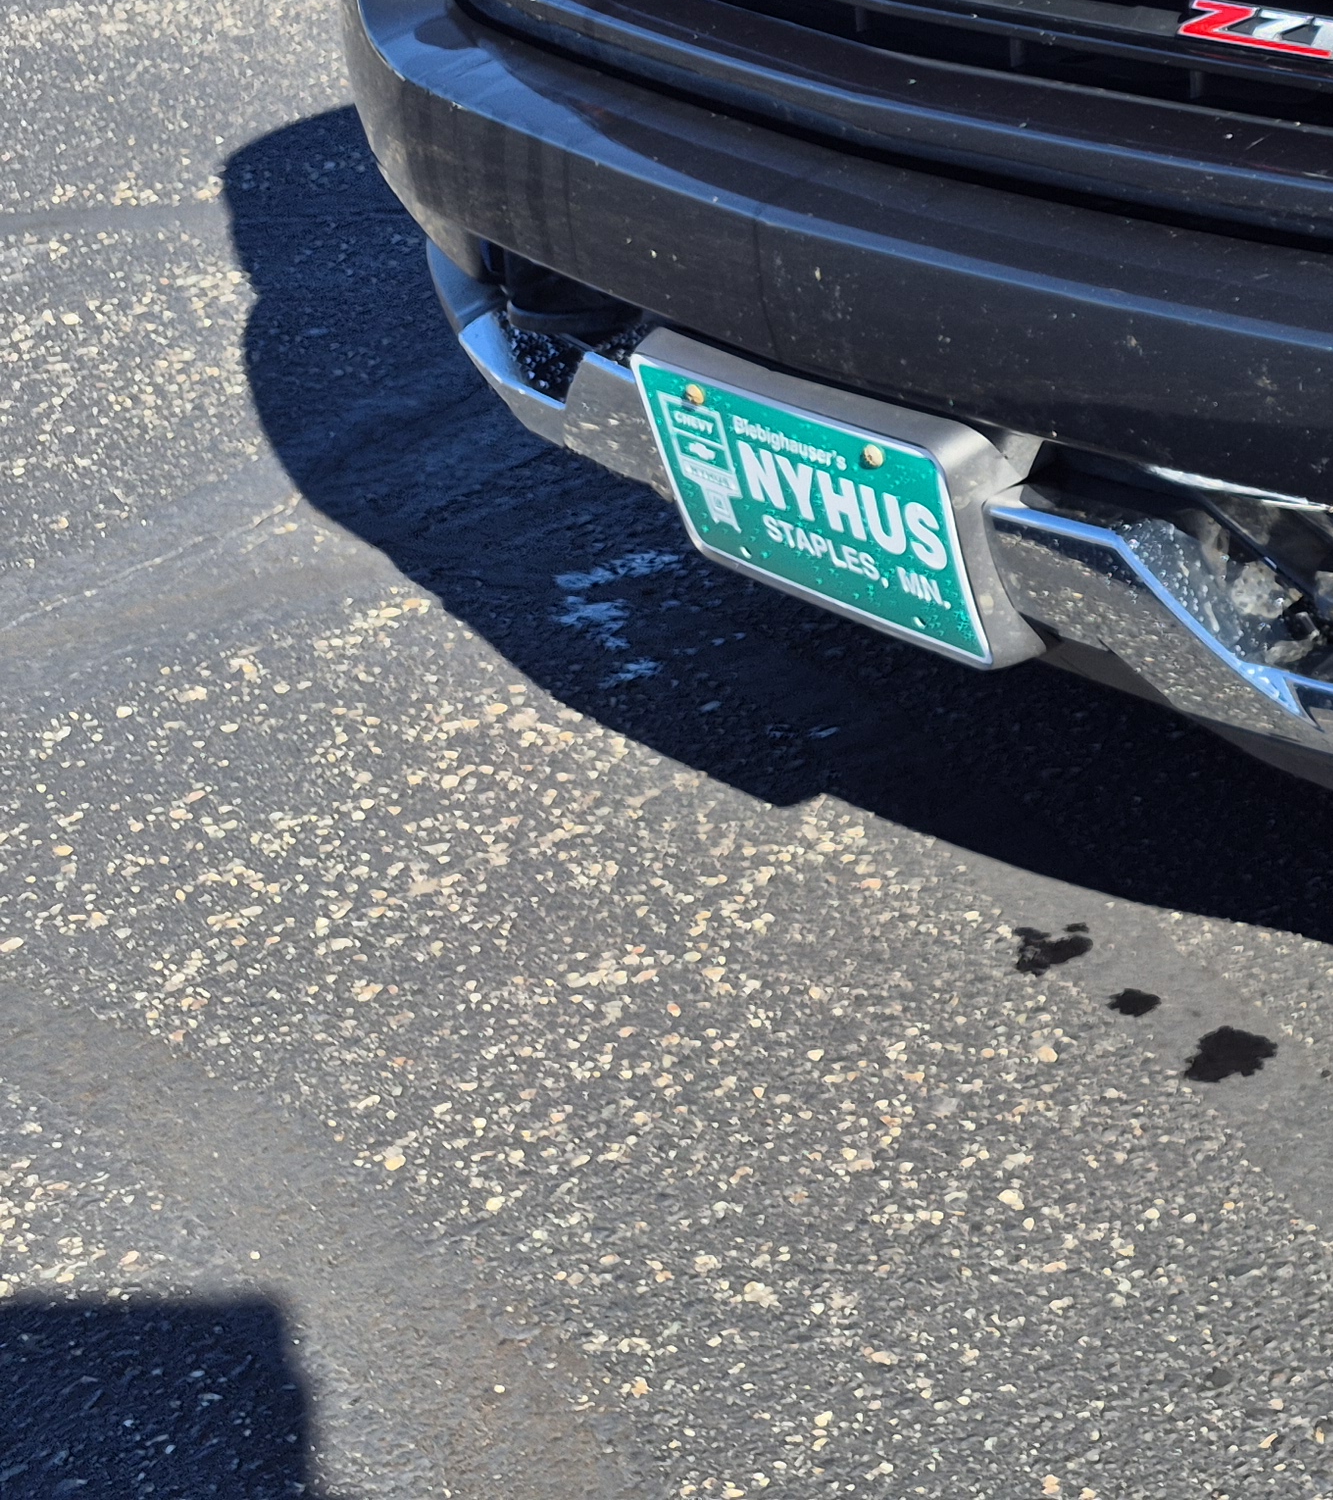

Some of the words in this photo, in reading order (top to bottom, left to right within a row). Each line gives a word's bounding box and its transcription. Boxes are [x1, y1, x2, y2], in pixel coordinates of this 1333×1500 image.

[673, 410, 714, 435] CHEVY
[737, 440, 947, 570] NYHUS
[762, 514, 889, 588] STAPLES,
[896, 566, 951, 610] MN.
